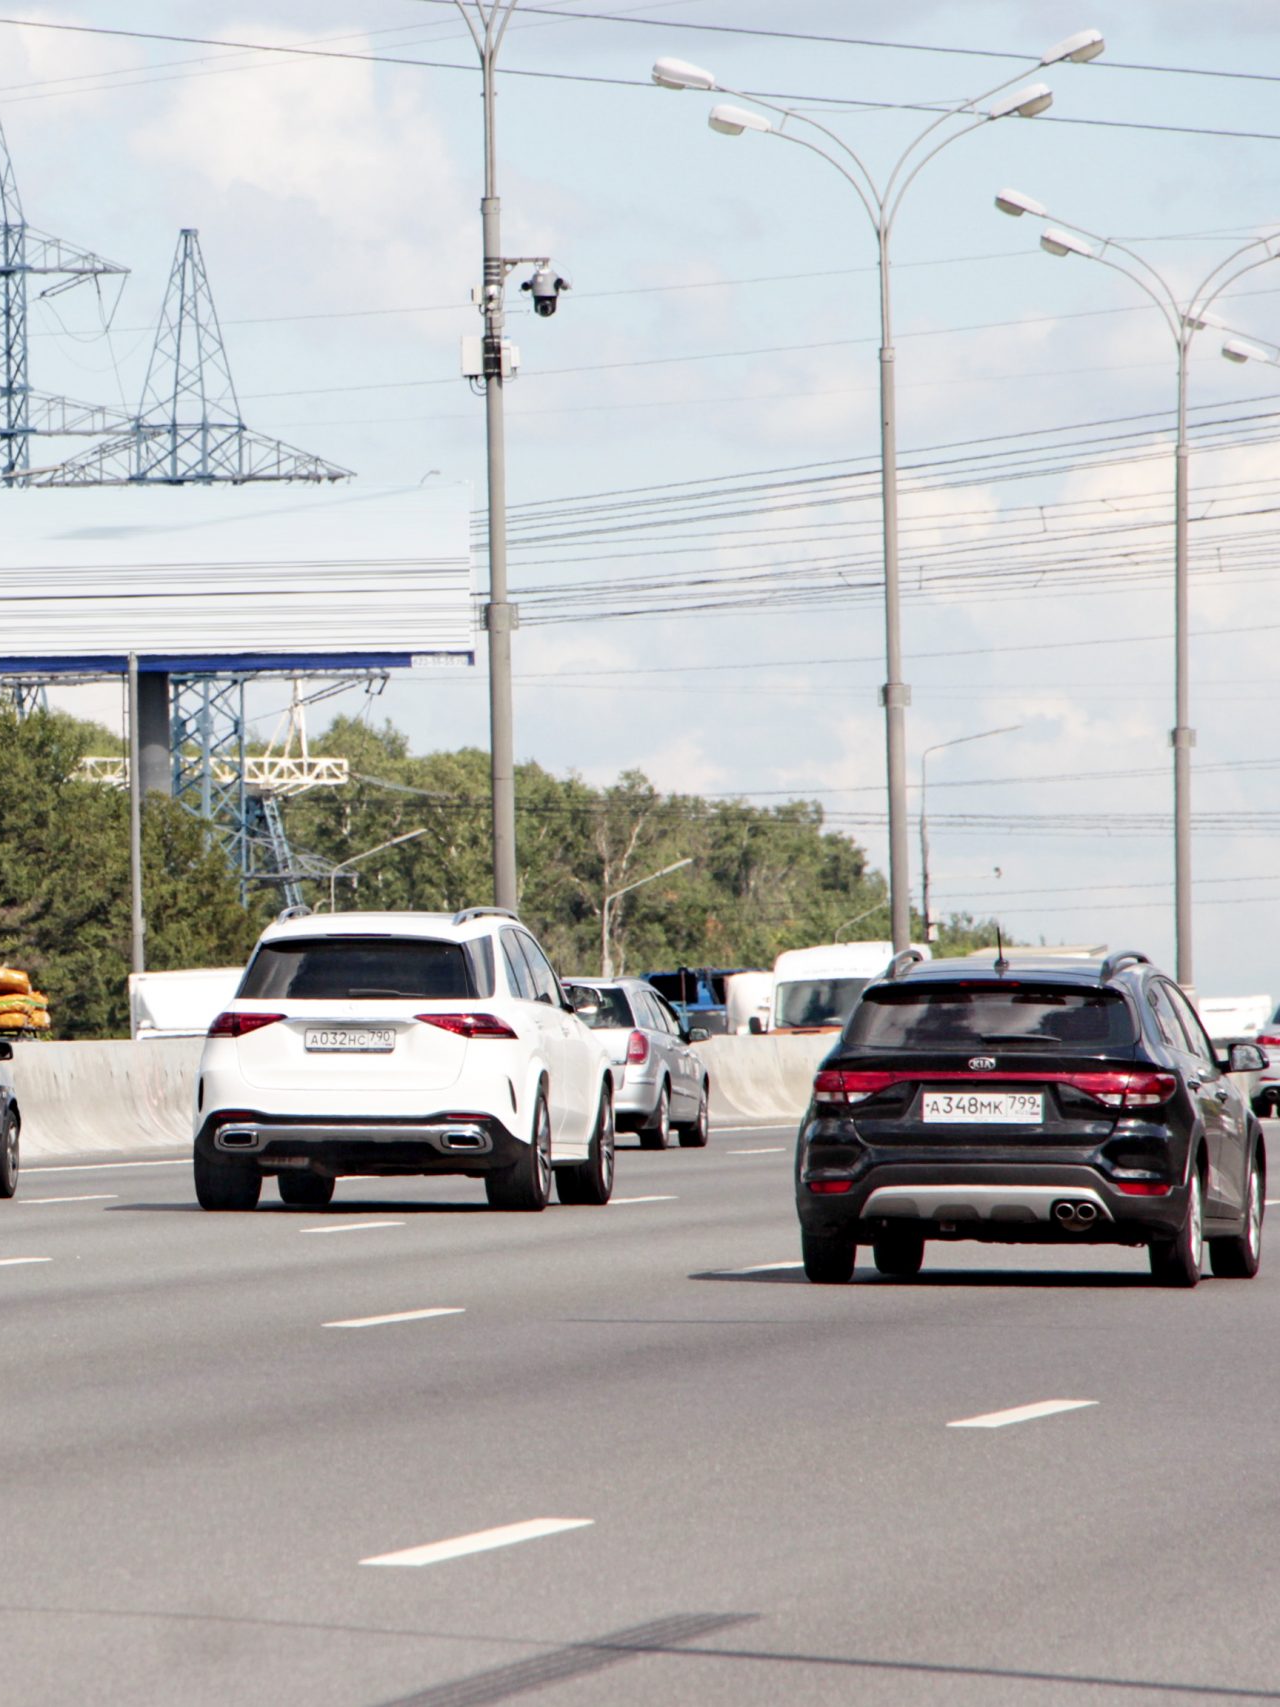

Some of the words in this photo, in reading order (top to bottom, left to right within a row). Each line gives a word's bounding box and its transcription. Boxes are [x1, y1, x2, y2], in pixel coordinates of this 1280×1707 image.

[310, 1031, 366, 1045] А032НС
[369, 1030, 391, 1041] 790
[930, 1096, 1003, 1114] А348МК
[1008, 1096, 1037, 1110] 799
